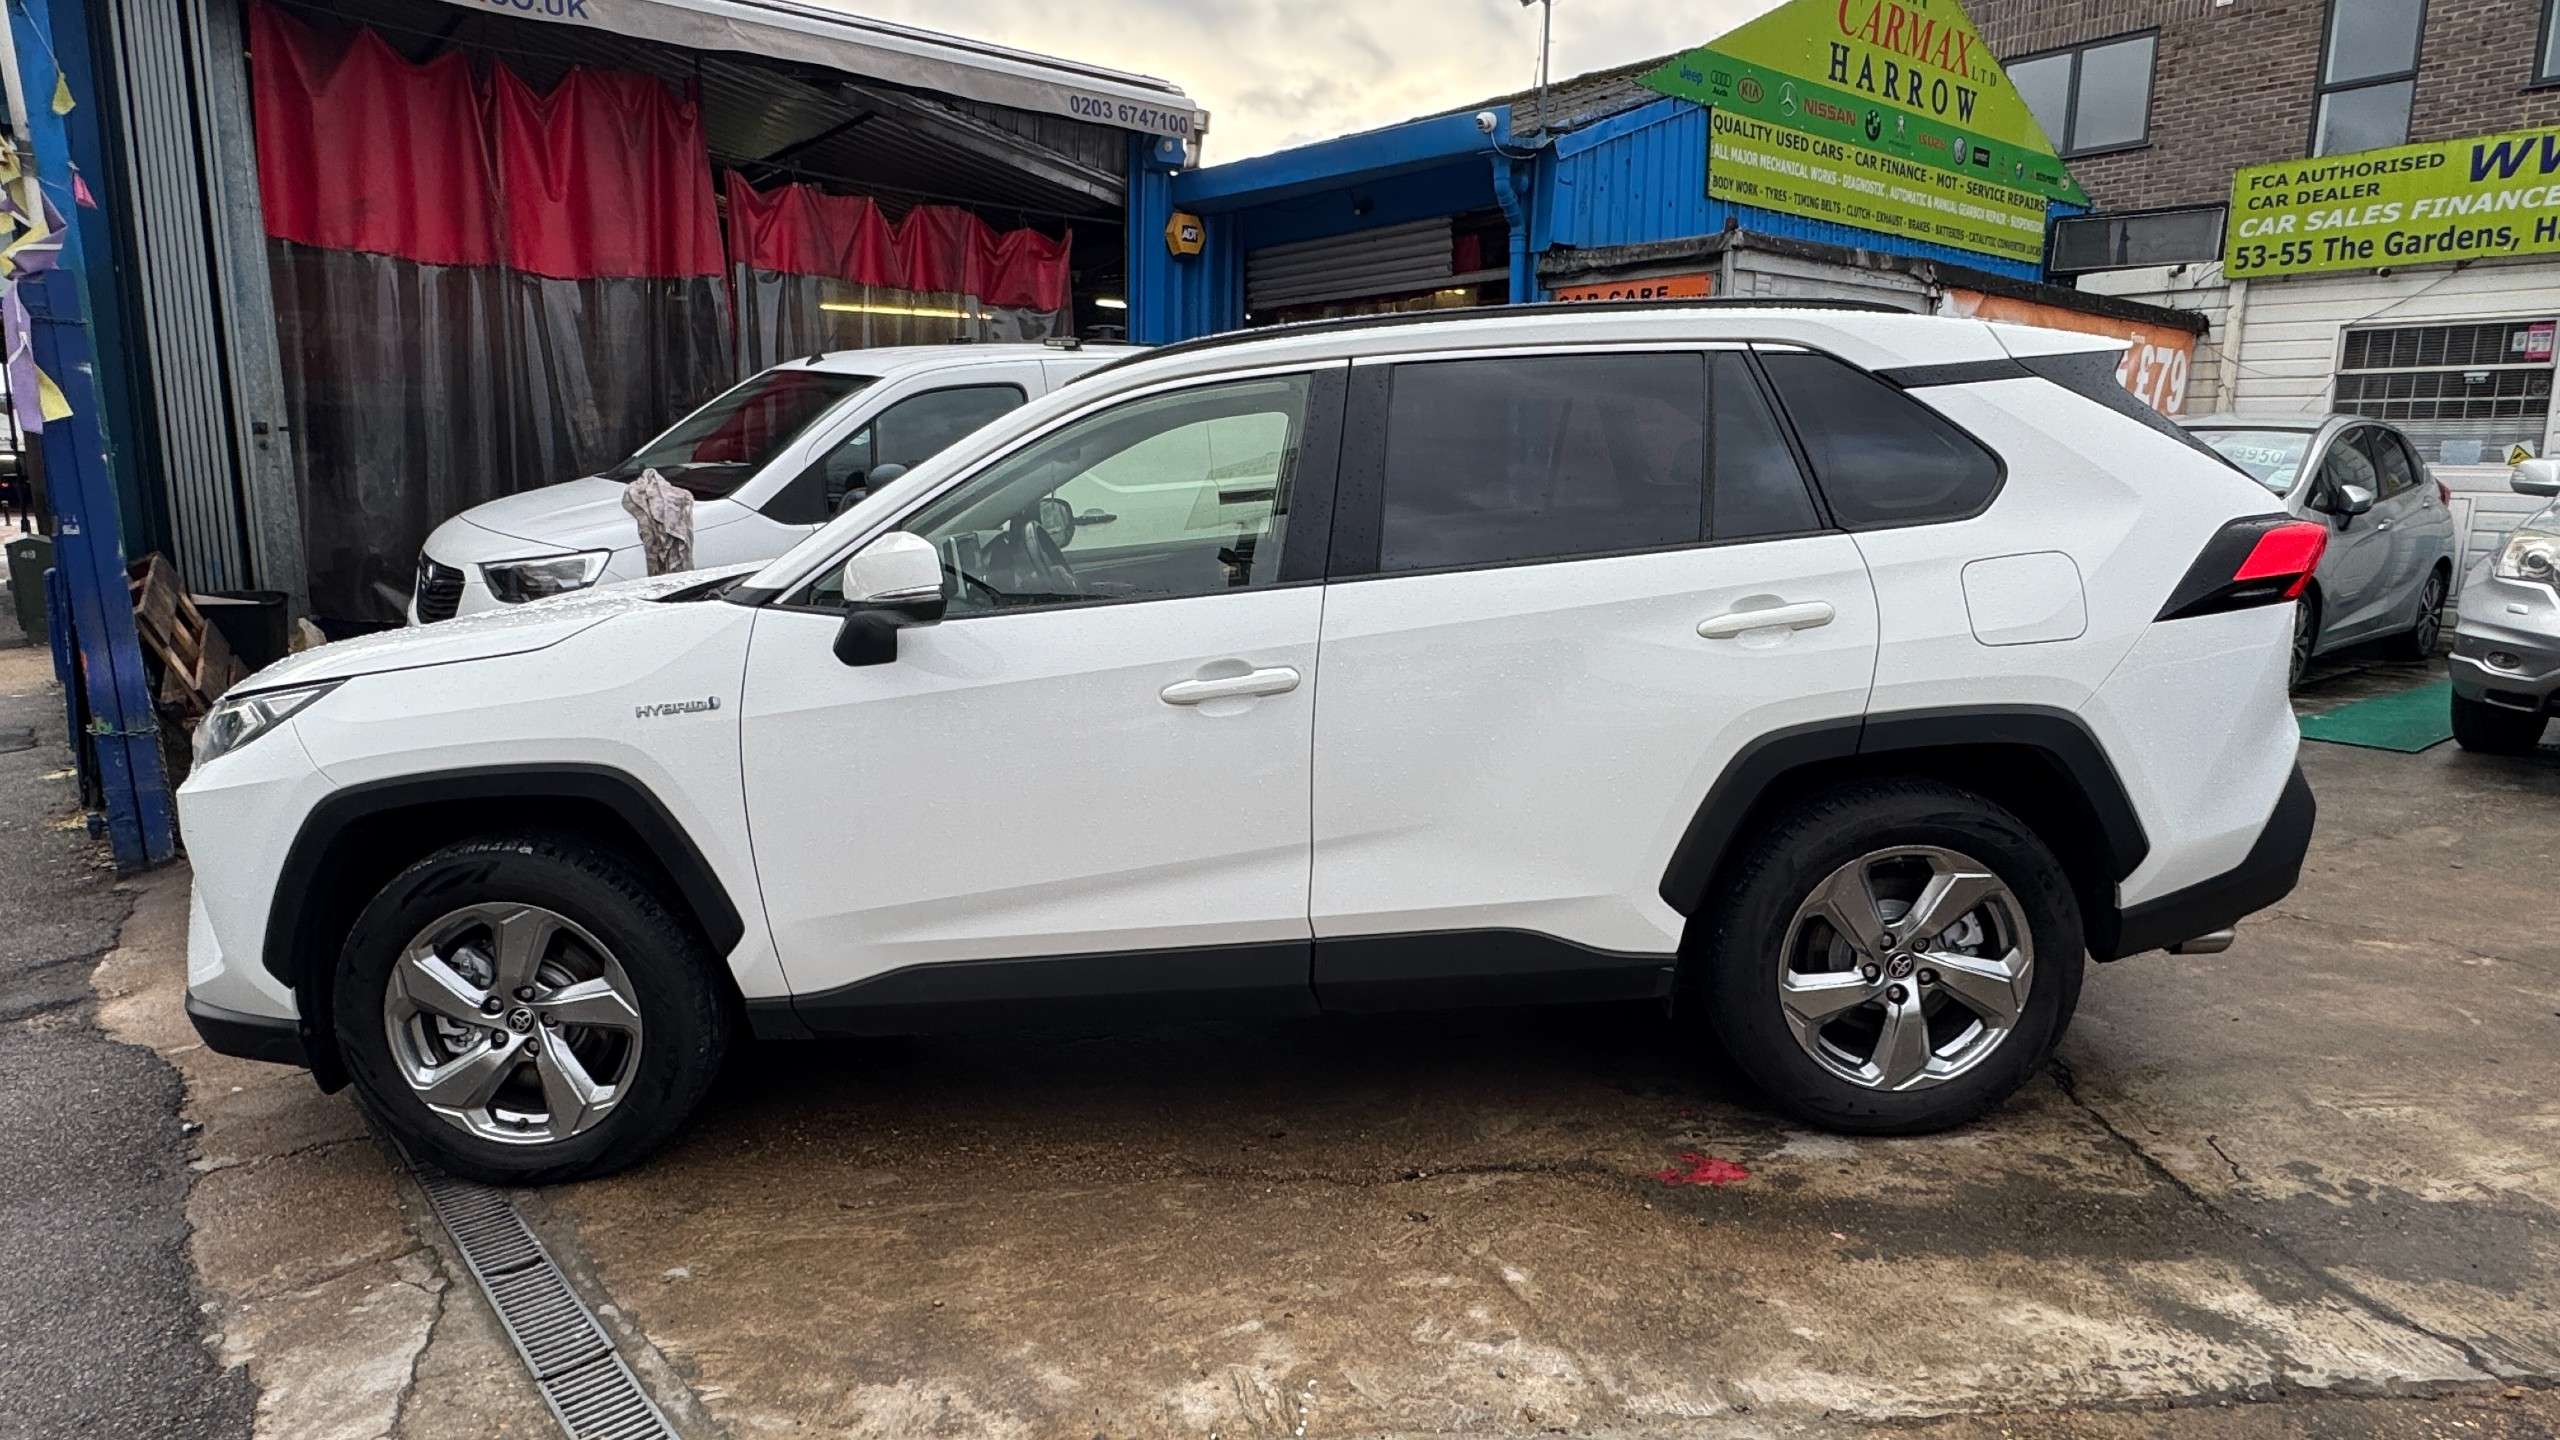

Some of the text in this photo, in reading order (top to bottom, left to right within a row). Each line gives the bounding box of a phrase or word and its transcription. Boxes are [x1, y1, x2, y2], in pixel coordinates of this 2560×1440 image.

[1838, 0, 1998, 87] CARMAX LTD
[1680, 64, 1703, 86] Jeep
[1741, 81, 1760, 99] KIA
[1828, 41, 1978, 124] HARROW
[1070, 95, 1188, 134] 0203 6747100
[1803, 98, 1857, 127] NISSAN
[1713, 113, 2045, 213] QUALITY USED CARS CAR FINANCE MOT SERVICE REPAIRS
[1713, 143, 1729, 160] ALL
[1730, 146, 1758, 167] MAJOR
[1760, 154, 1808, 179] MECHANICAL
[1811, 166, 1838, 185] WORKS
[2251, 153, 2445, 190] FCA AUTHORISED
[1712, 175, 1733, 190] BODY
[1736, 178, 1758, 195] WORK
[1766, 187, 1787, 202] TYRES
[1794, 192, 1819, 209] TIMING
[1821, 199, 1840, 214] BELTS
[1847, 204, 1870, 220] CLUTCH
[1876, 211, 1903, 227] EXHAUST
[1908, 218, 1929, 233] BRAKES
[2239, 185, 2560, 238] CAR SALES FINANCE
[2248, 183, 2380, 210] CAR DEALER
[1182, 227, 1198, 241] ADT
[2235, 216, 2560, 270] 53-55 The Gardens, H
[2134, 344, 2187, 413] £79
[635, 700, 708, 718] HYBRID
